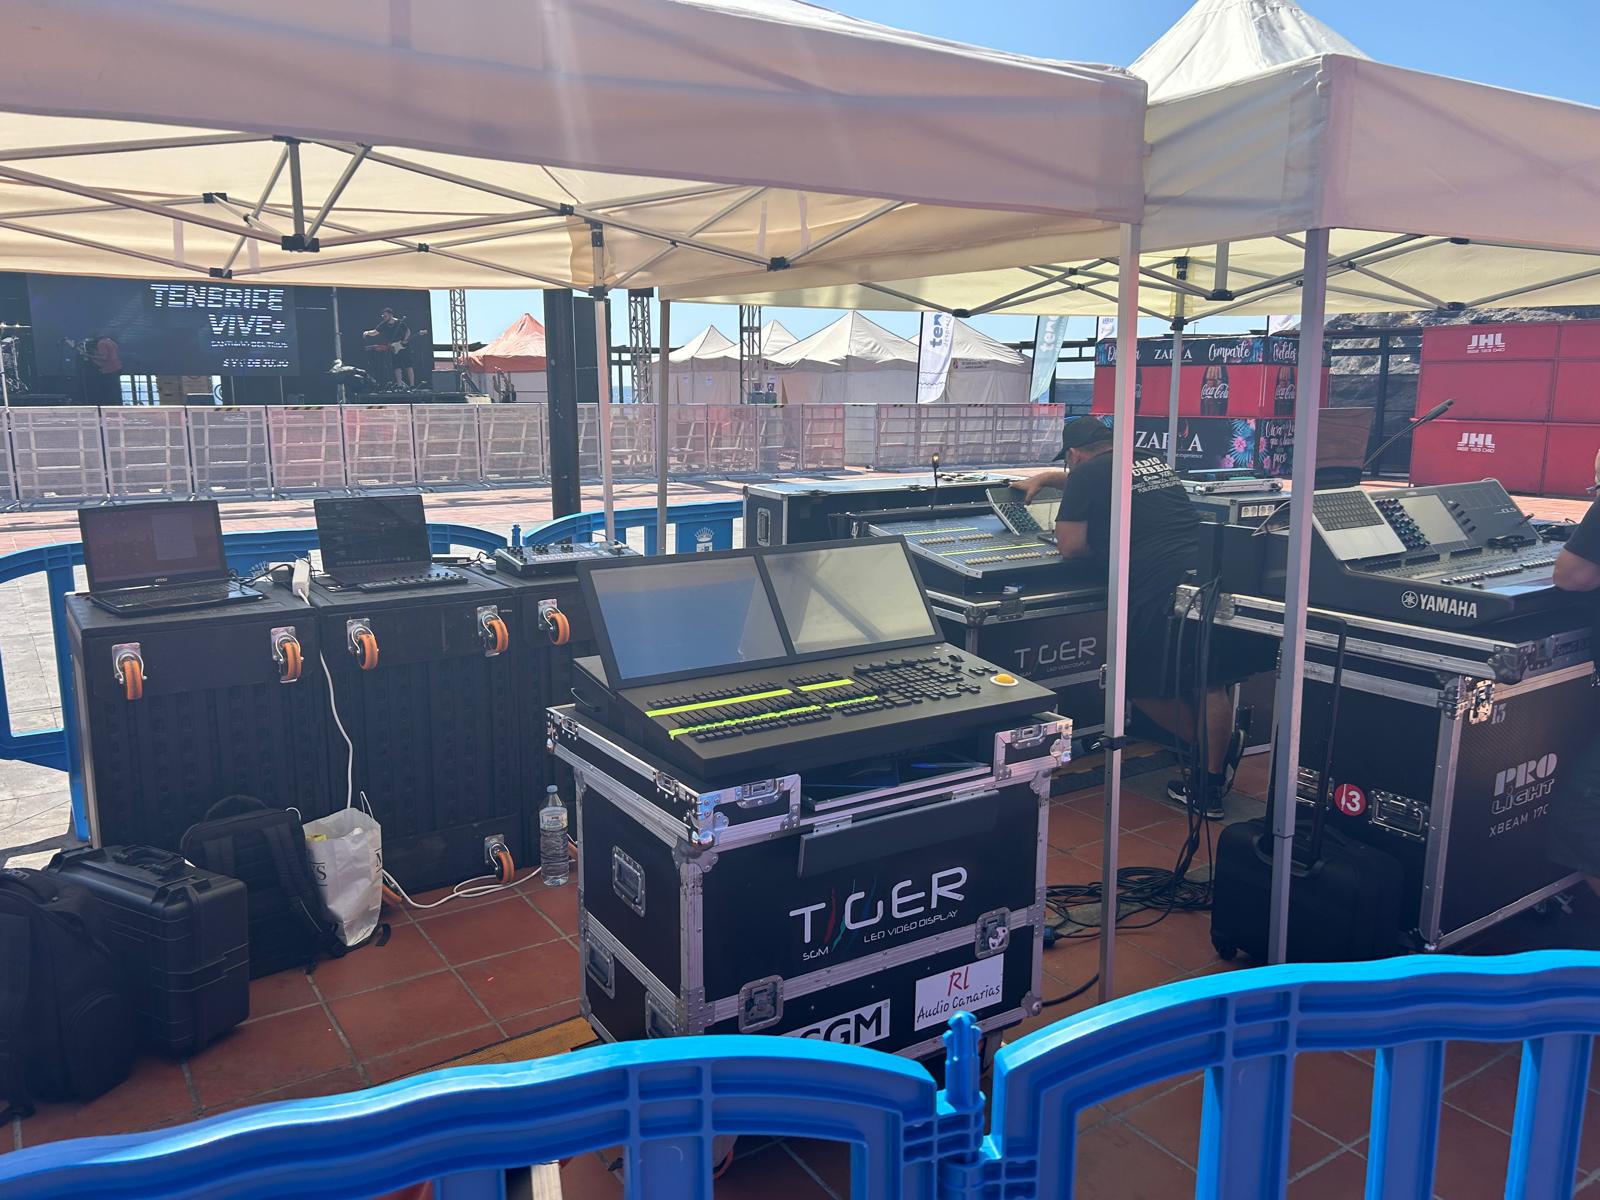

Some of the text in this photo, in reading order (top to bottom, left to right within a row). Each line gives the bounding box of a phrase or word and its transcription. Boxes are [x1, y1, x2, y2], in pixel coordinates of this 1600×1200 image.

[150, 284, 284, 311] TENERIFE
[1208, 340, 1250, 364] Comparte
[1467, 333, 1506, 349] JHL
[1457, 433, 1495, 448] JHL
[1420, 593, 1477, 619] YAMAHA
[1494, 753, 1558, 797] PRO
[1489, 813, 1529, 838] XBEAM
[864, 930, 885, 943] LED
[888, 920, 917, 935] VIDEO
[919, 909, 959, 928] DISPLAY
[916, 984, 1001, 1023] Audio Canarias
